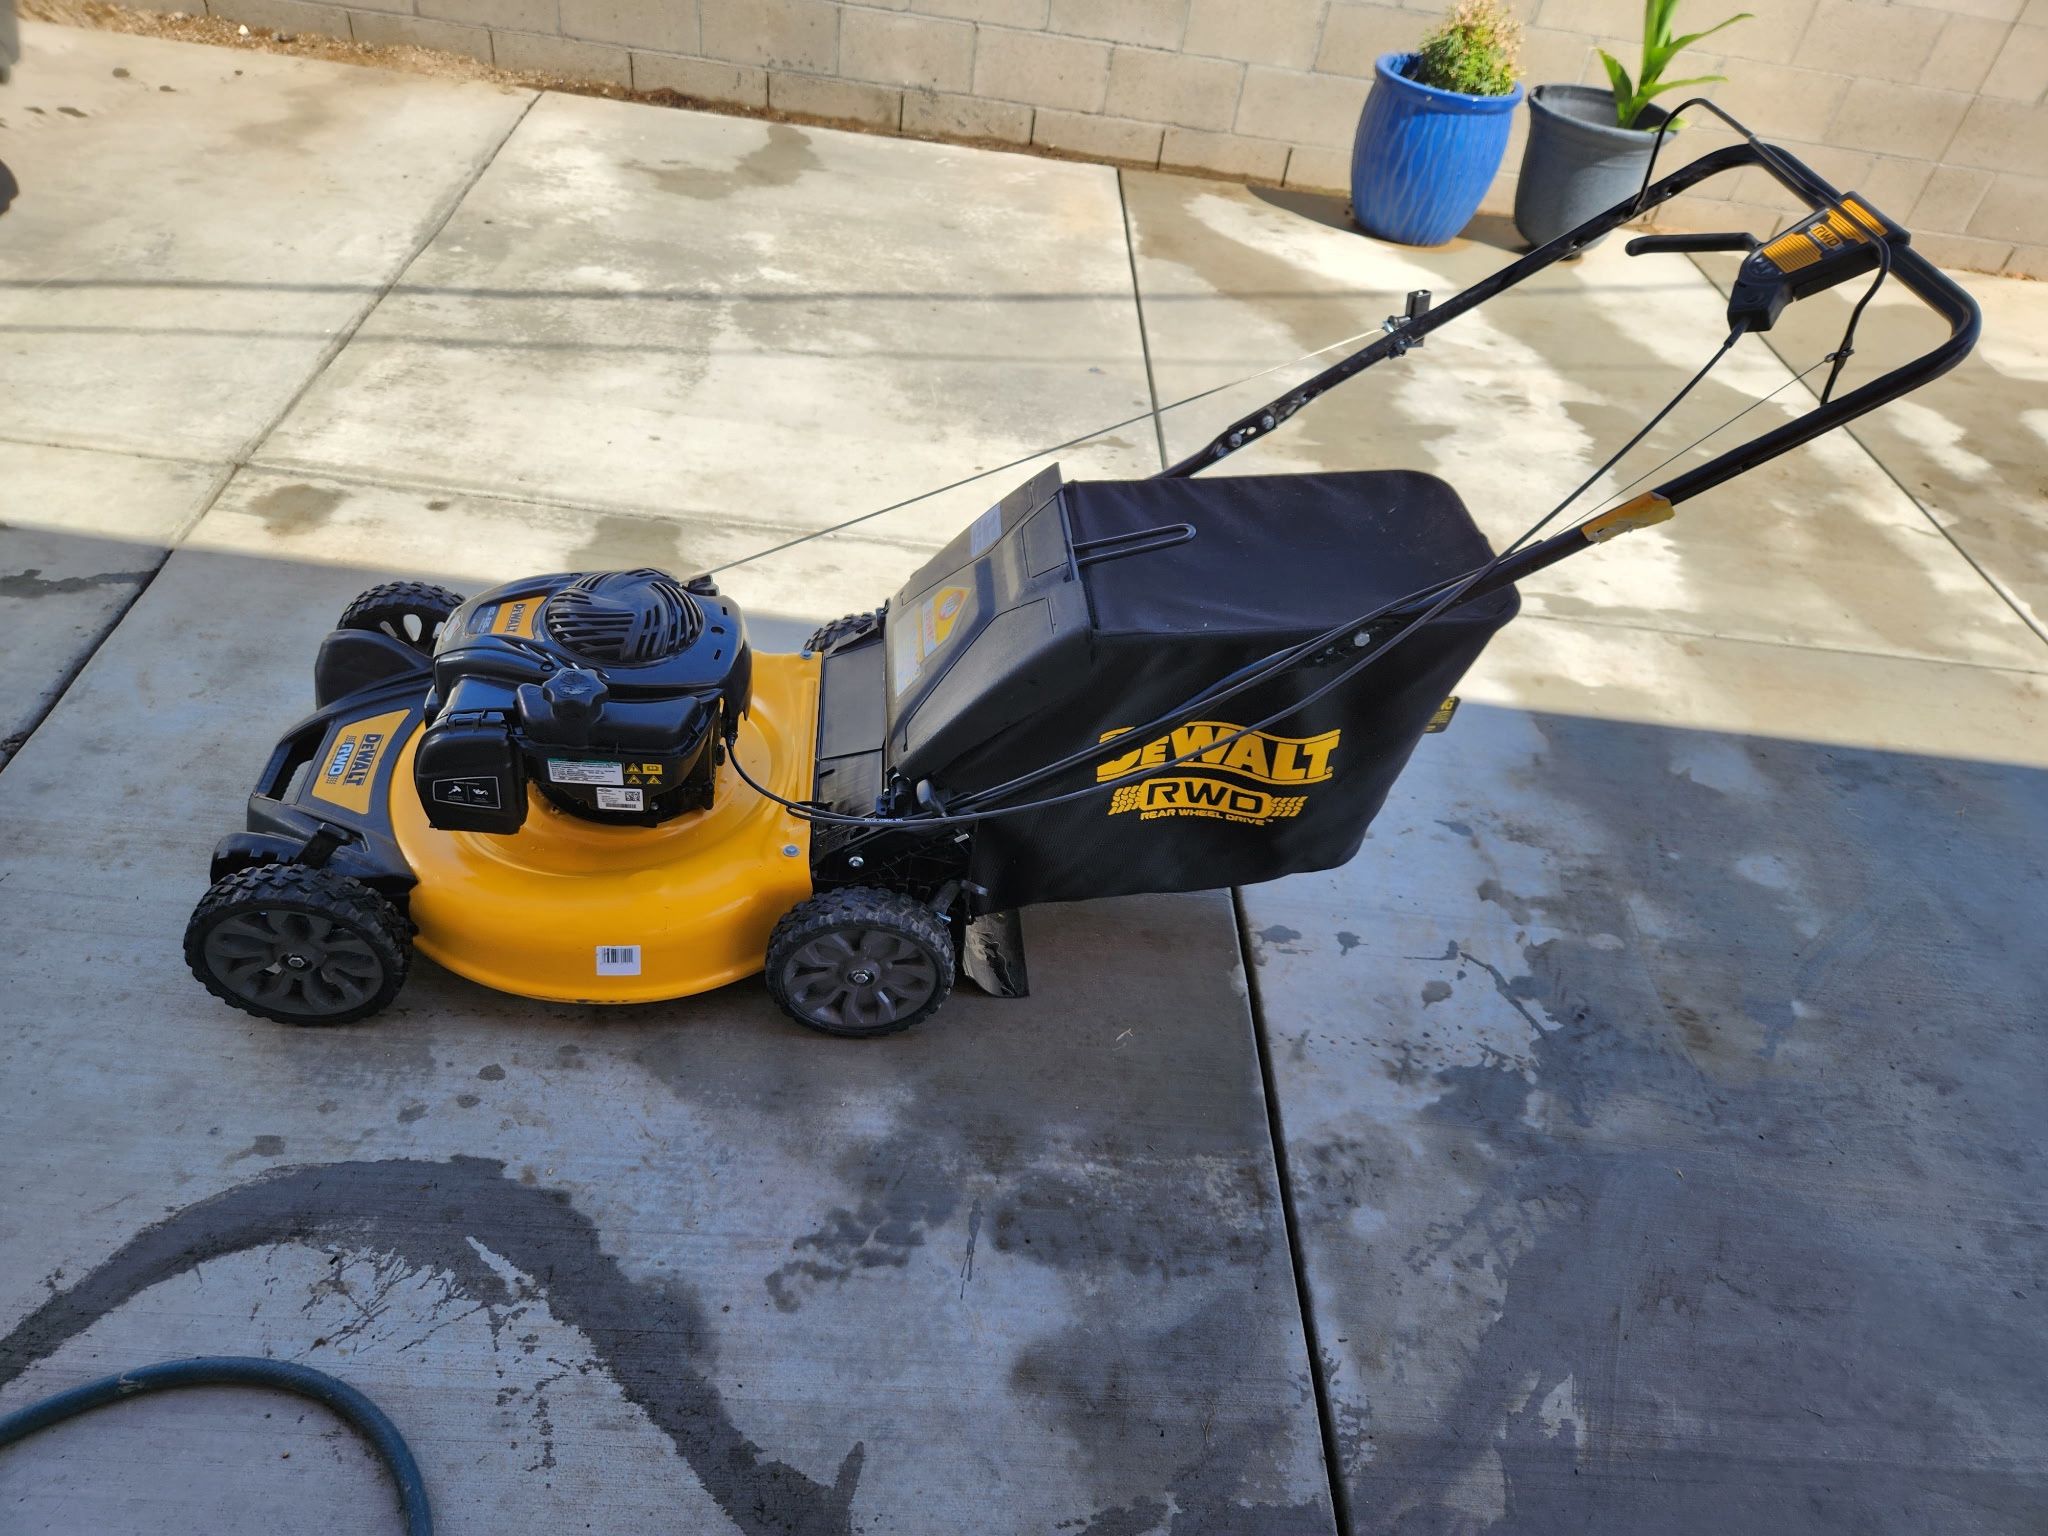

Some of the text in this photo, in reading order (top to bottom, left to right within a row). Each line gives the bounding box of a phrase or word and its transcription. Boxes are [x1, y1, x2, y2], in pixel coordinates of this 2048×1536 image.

[1812, 225, 1841, 247] RWD
[505, 603, 526, 632] DEWALT
[329, 742, 355, 776] RWD
[343, 733, 384, 786] DEWALT
[1147, 781, 1264, 814] RWD
[1140, 808, 1266, 826] REAR WHEEL DRIVE
